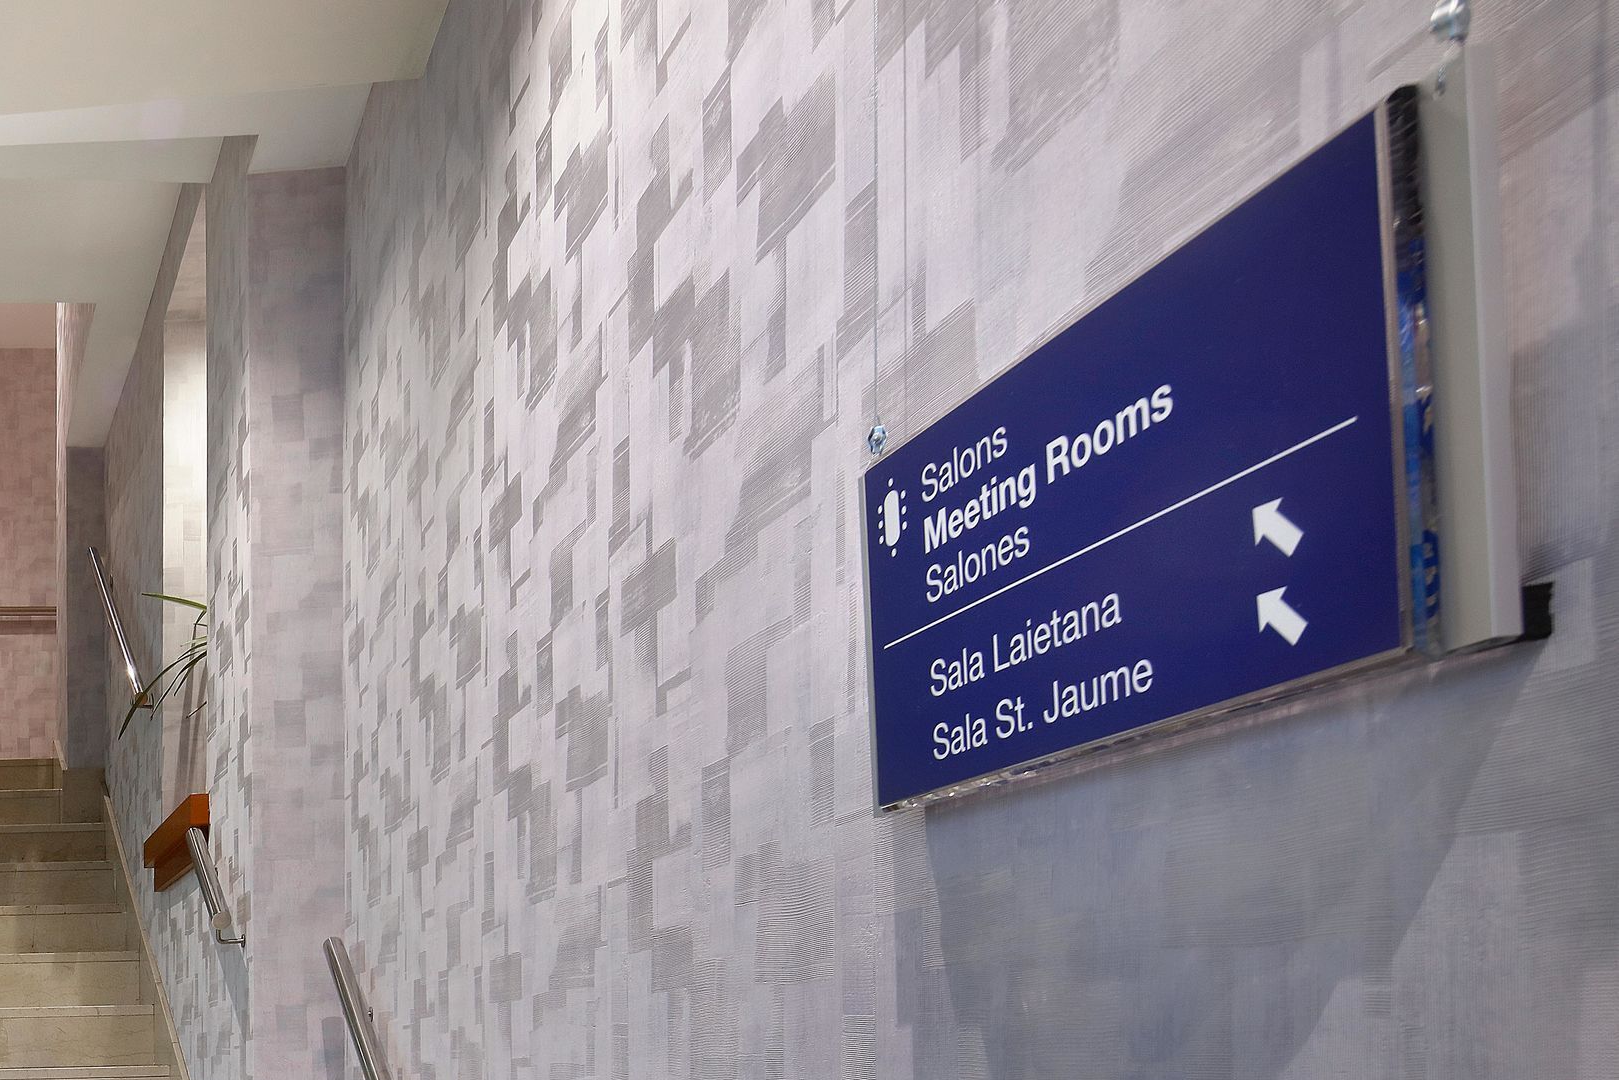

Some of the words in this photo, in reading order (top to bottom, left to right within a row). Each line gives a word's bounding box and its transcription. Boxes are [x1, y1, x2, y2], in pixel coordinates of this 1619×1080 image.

[920, 425, 1009, 504] Salons
[922, 462, 1037, 556] Meeting
[1044, 382, 1175, 485] Rooms
[925, 524, 1031, 603] Salones
[929, 646, 986, 698] Sala
[992, 592, 1123, 673] Laietana
[932, 713, 988, 762] Sala
[995, 694, 1034, 740] St.
[1042, 657, 1155, 726] Jaume
